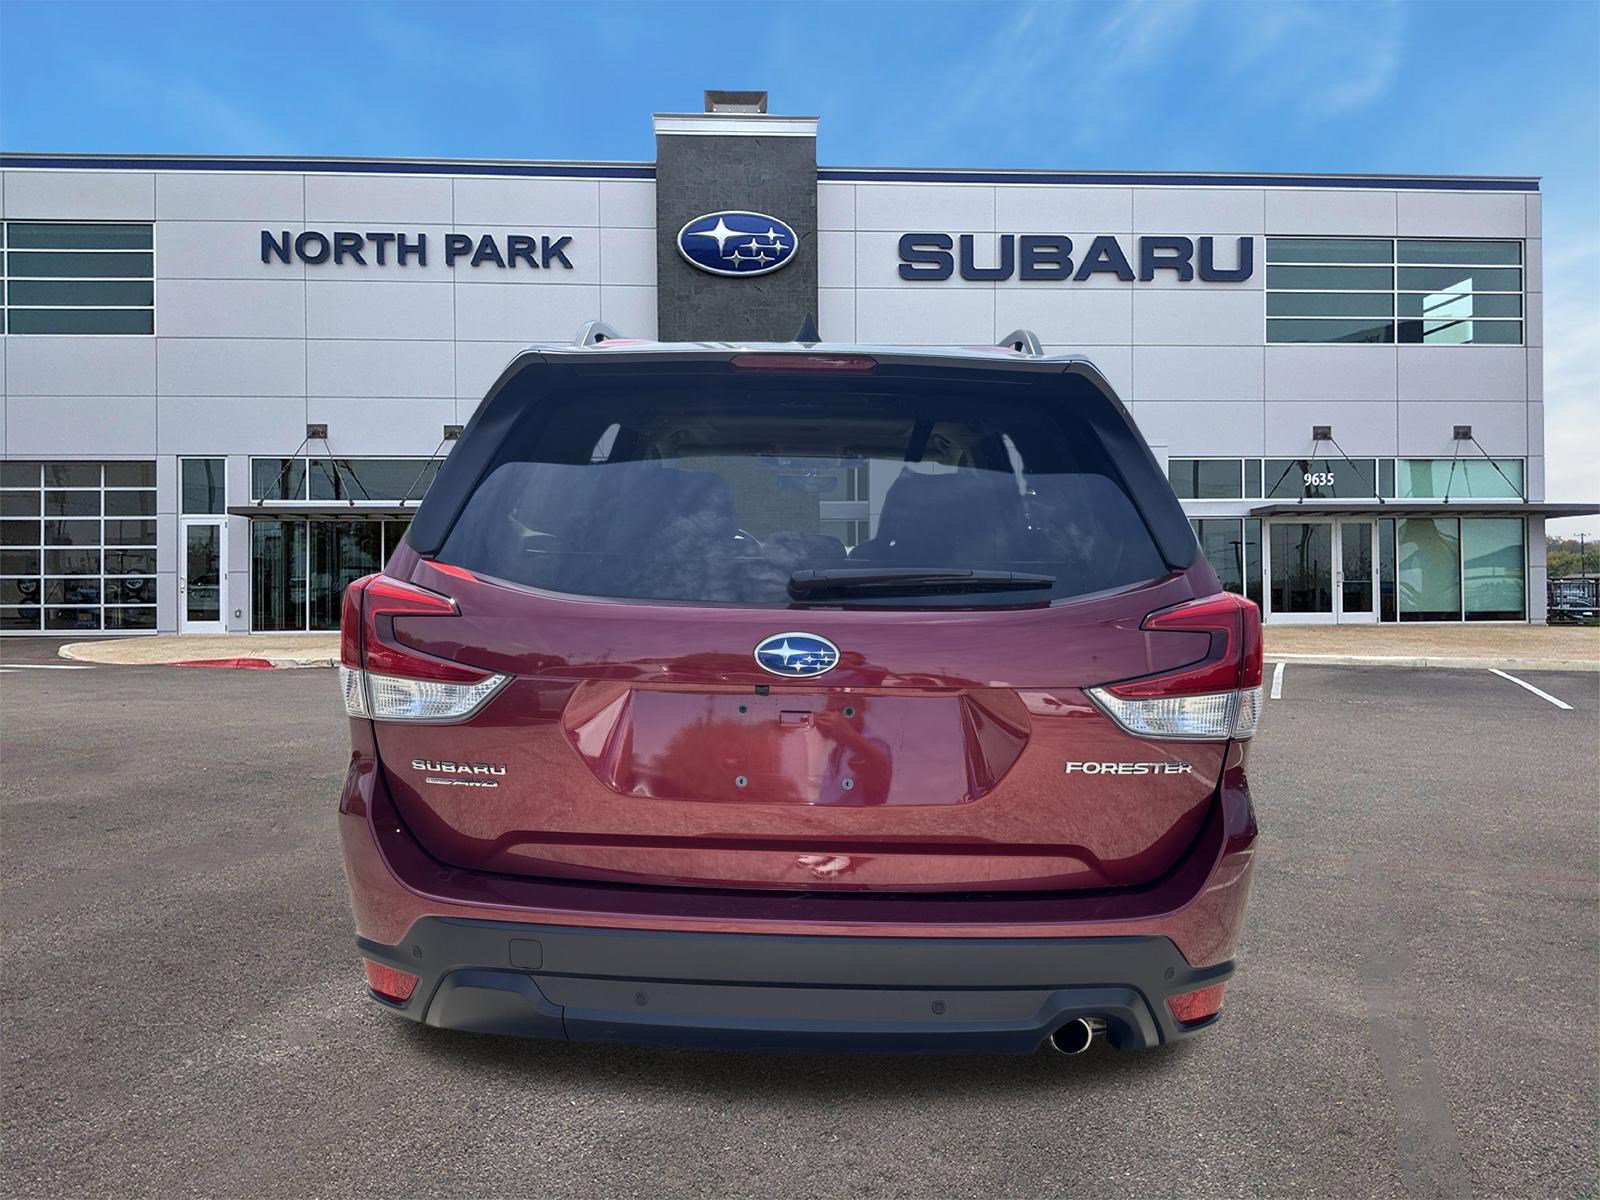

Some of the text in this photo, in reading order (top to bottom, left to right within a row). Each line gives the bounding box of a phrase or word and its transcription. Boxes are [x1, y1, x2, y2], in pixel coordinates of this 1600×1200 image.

[261, 230, 573, 269] NORTH PARK
[898, 233, 1254, 282] SUBARU
[1303, 472, 1335, 486] 9635
[411, 759, 507, 776] SUBARU
[1065, 761, 1193, 775] FORESTER
